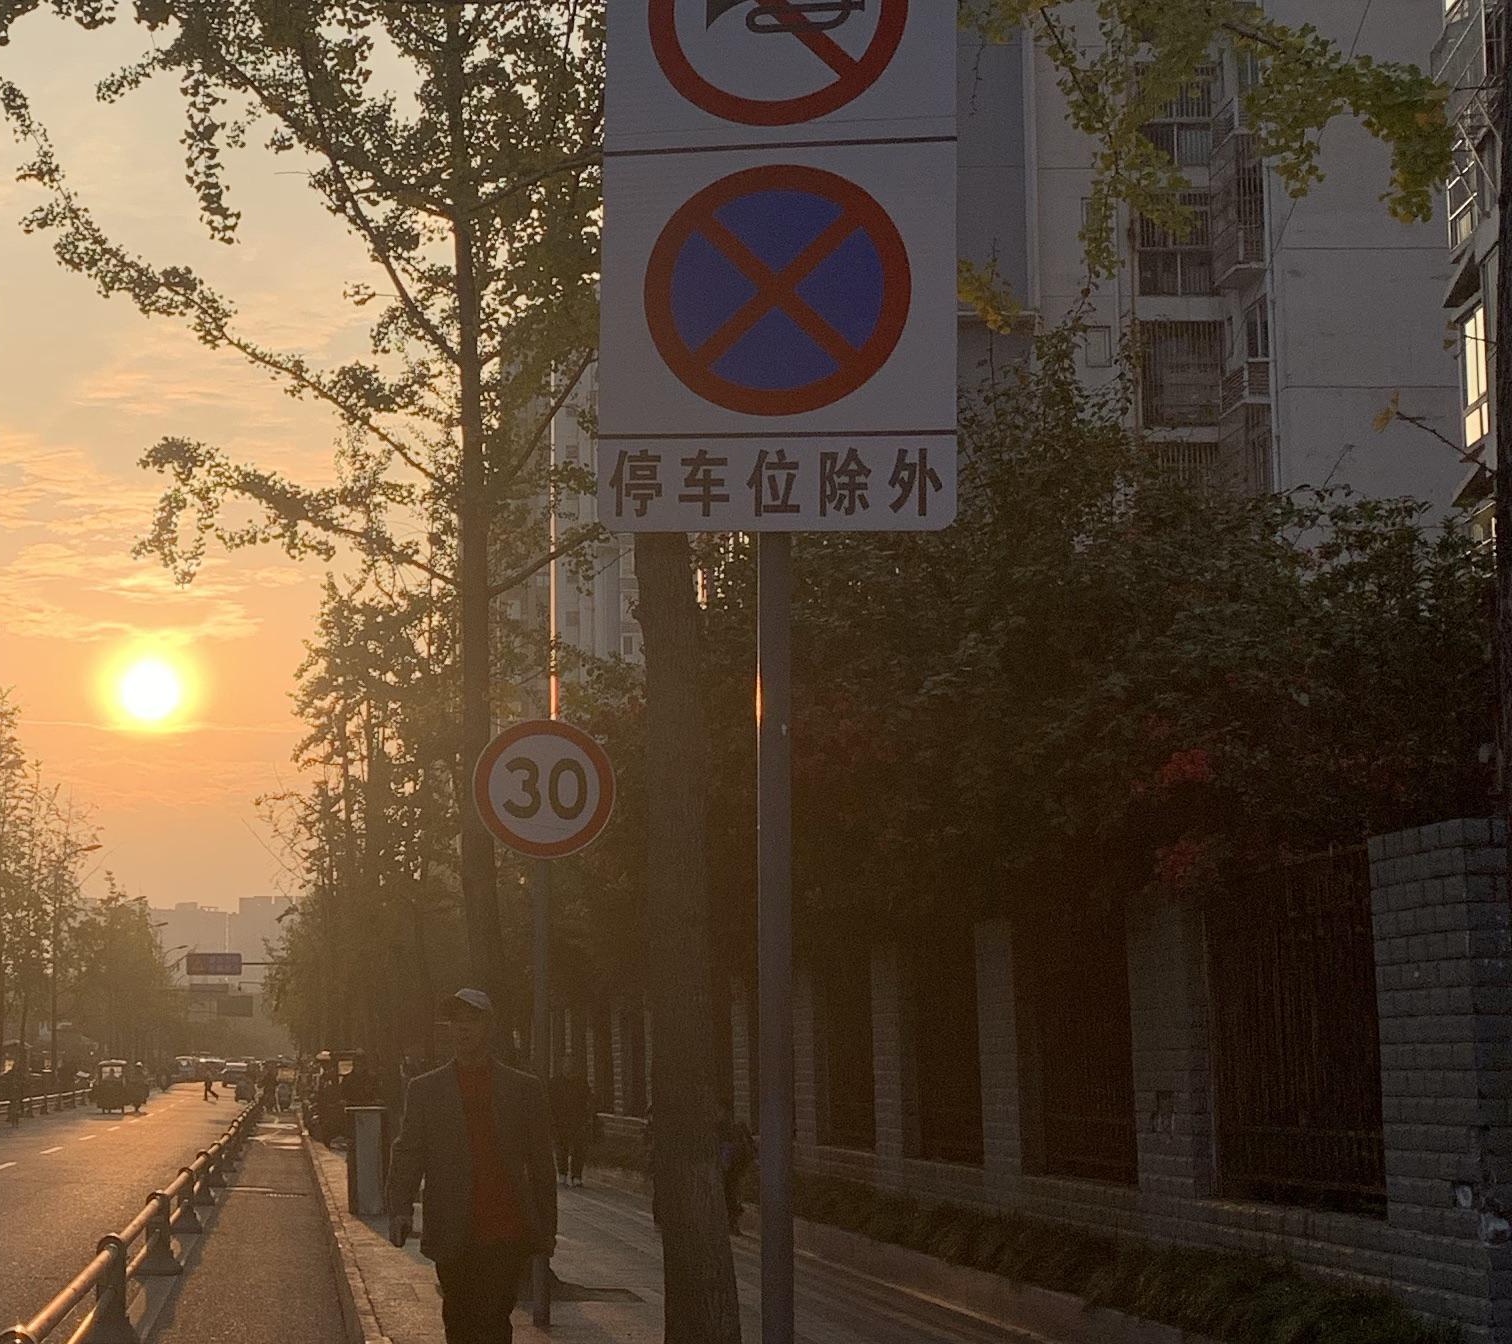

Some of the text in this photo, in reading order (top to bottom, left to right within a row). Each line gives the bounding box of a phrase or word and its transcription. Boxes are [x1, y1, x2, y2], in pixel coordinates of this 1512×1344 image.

[608, 447, 943, 518] 停车位除外
[502, 756, 588, 821] 30
